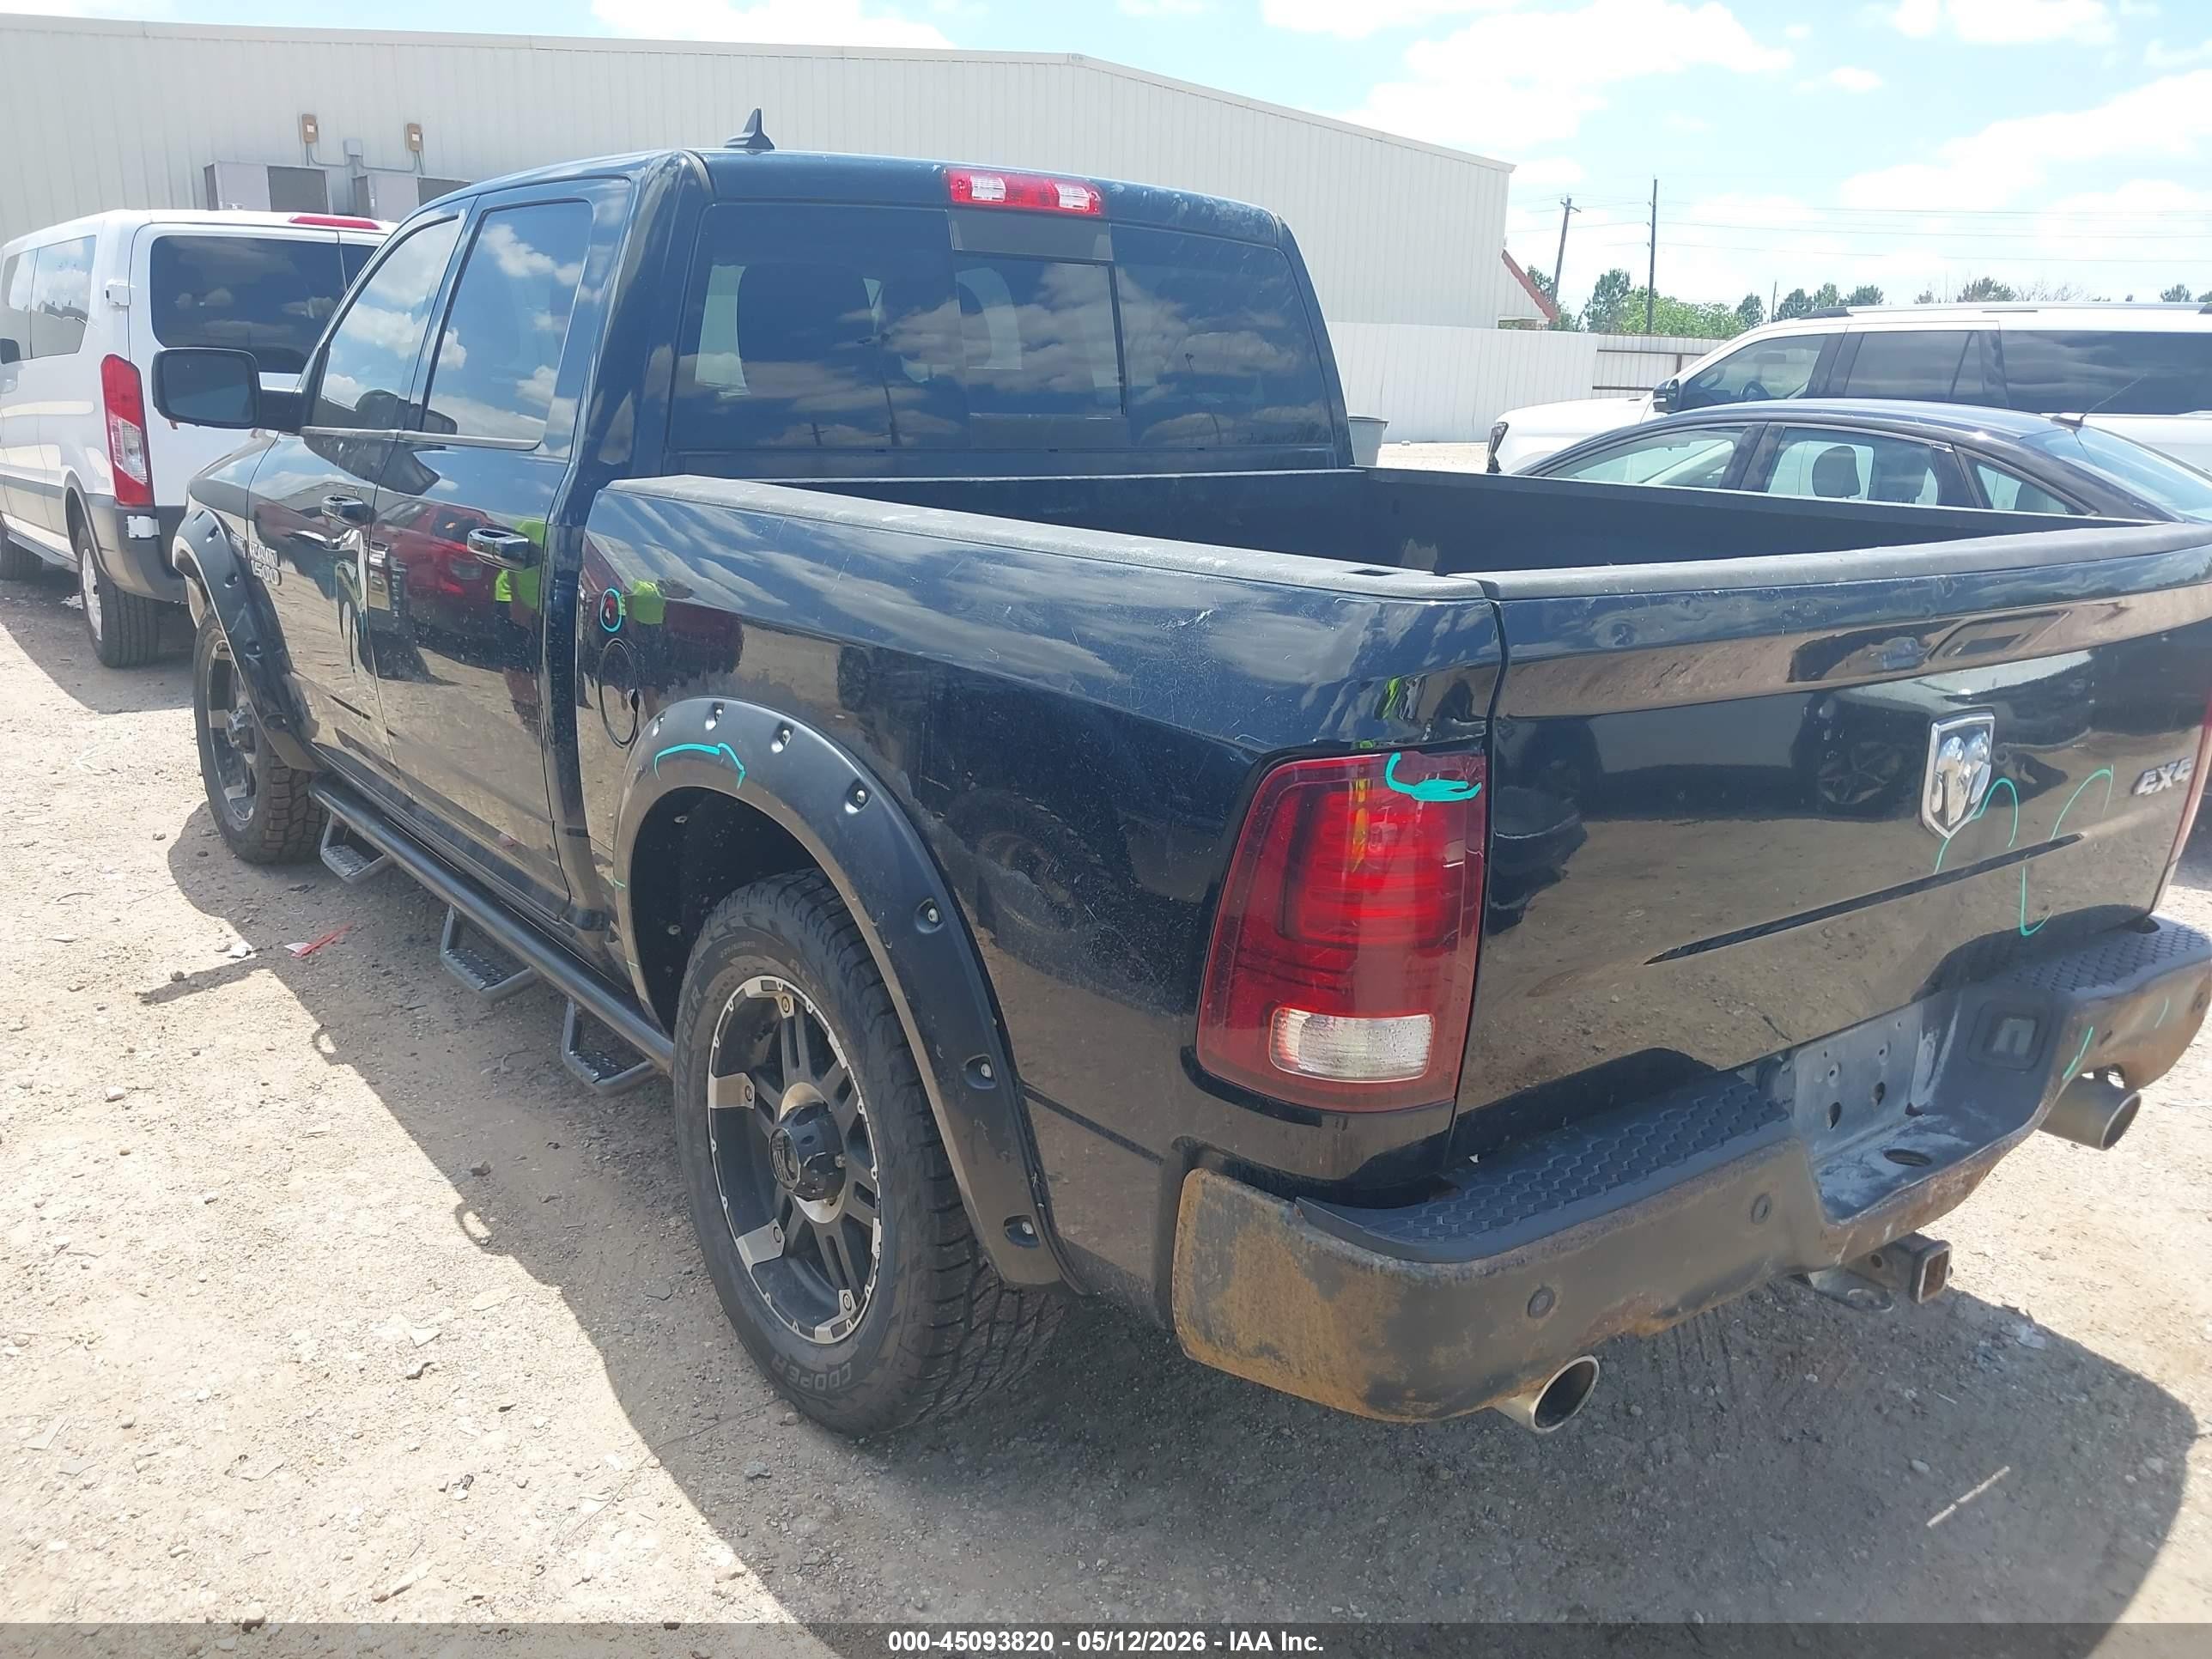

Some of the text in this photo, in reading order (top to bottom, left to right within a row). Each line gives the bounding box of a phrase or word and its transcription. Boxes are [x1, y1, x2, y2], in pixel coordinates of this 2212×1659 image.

[249, 542, 280, 568] RAM
[250, 559, 282, 586] 1500
[770, 1352, 853, 1392] COOPER
